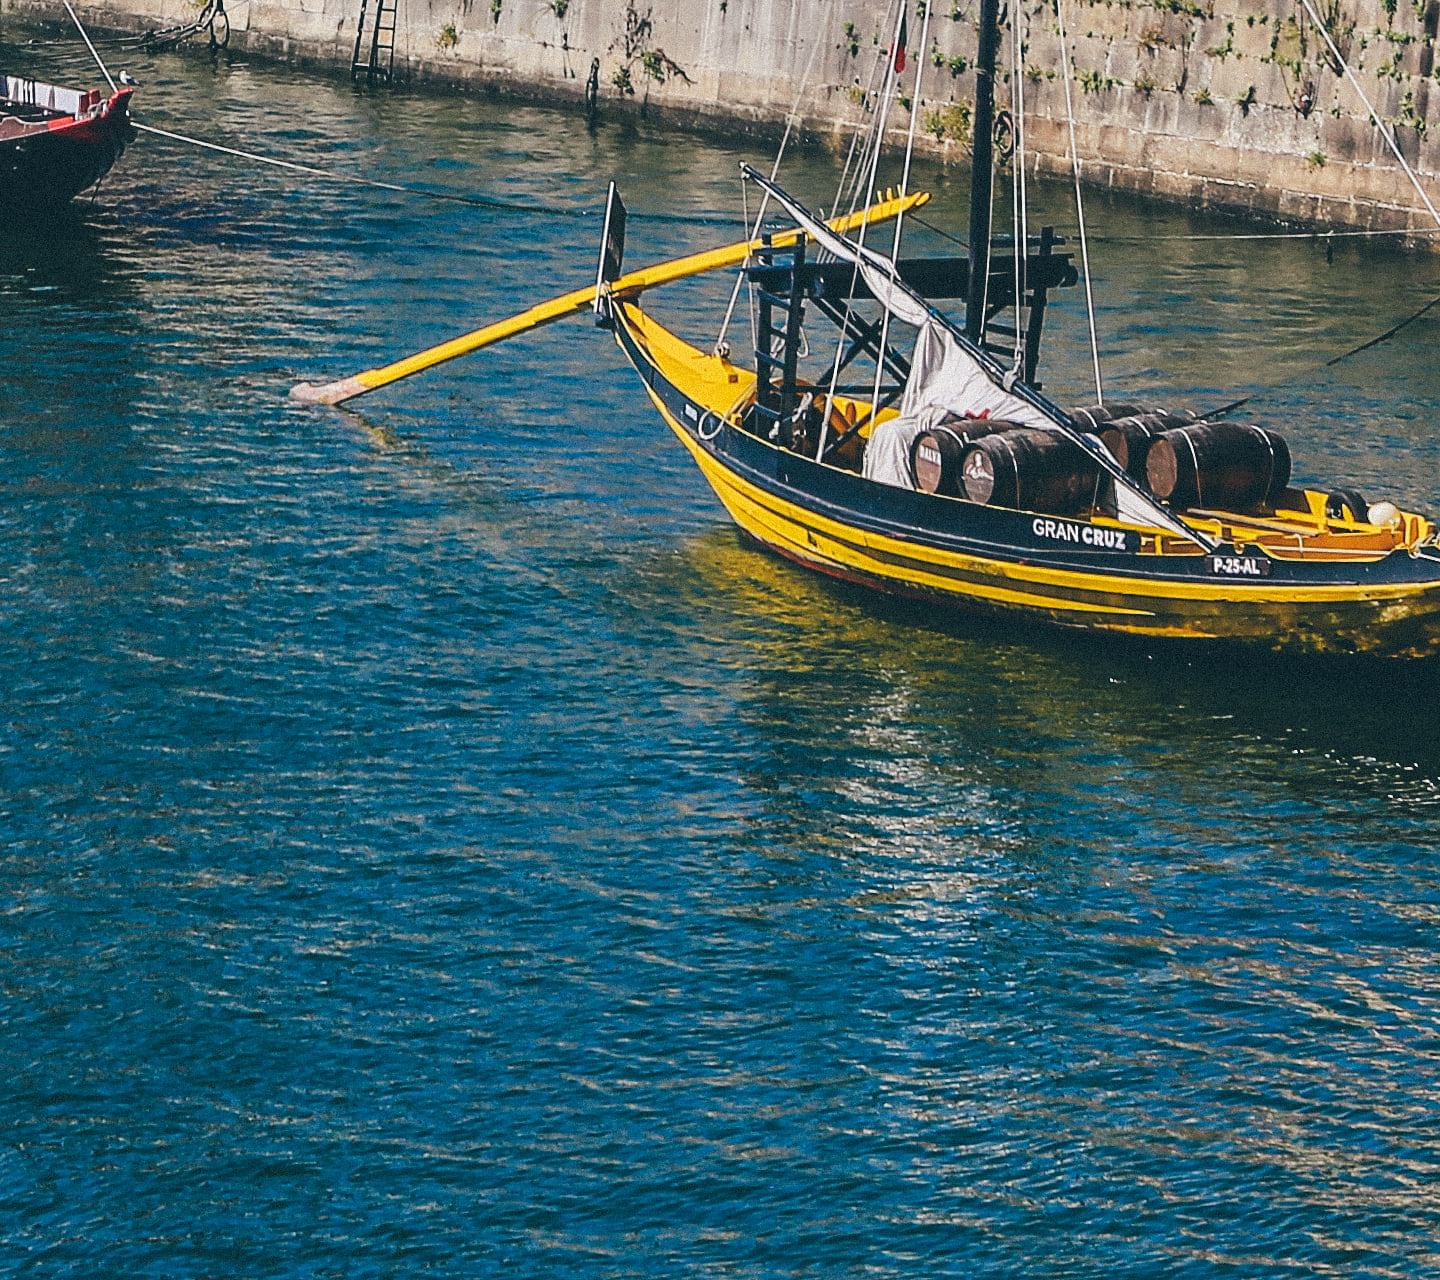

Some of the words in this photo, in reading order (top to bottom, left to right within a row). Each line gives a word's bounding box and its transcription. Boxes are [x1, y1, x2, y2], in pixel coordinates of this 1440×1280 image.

[1032, 518, 1079, 543] GRAN
[1083, 525, 1127, 550] CRUZ
[1213, 558, 1261, 575] P-25-AL
